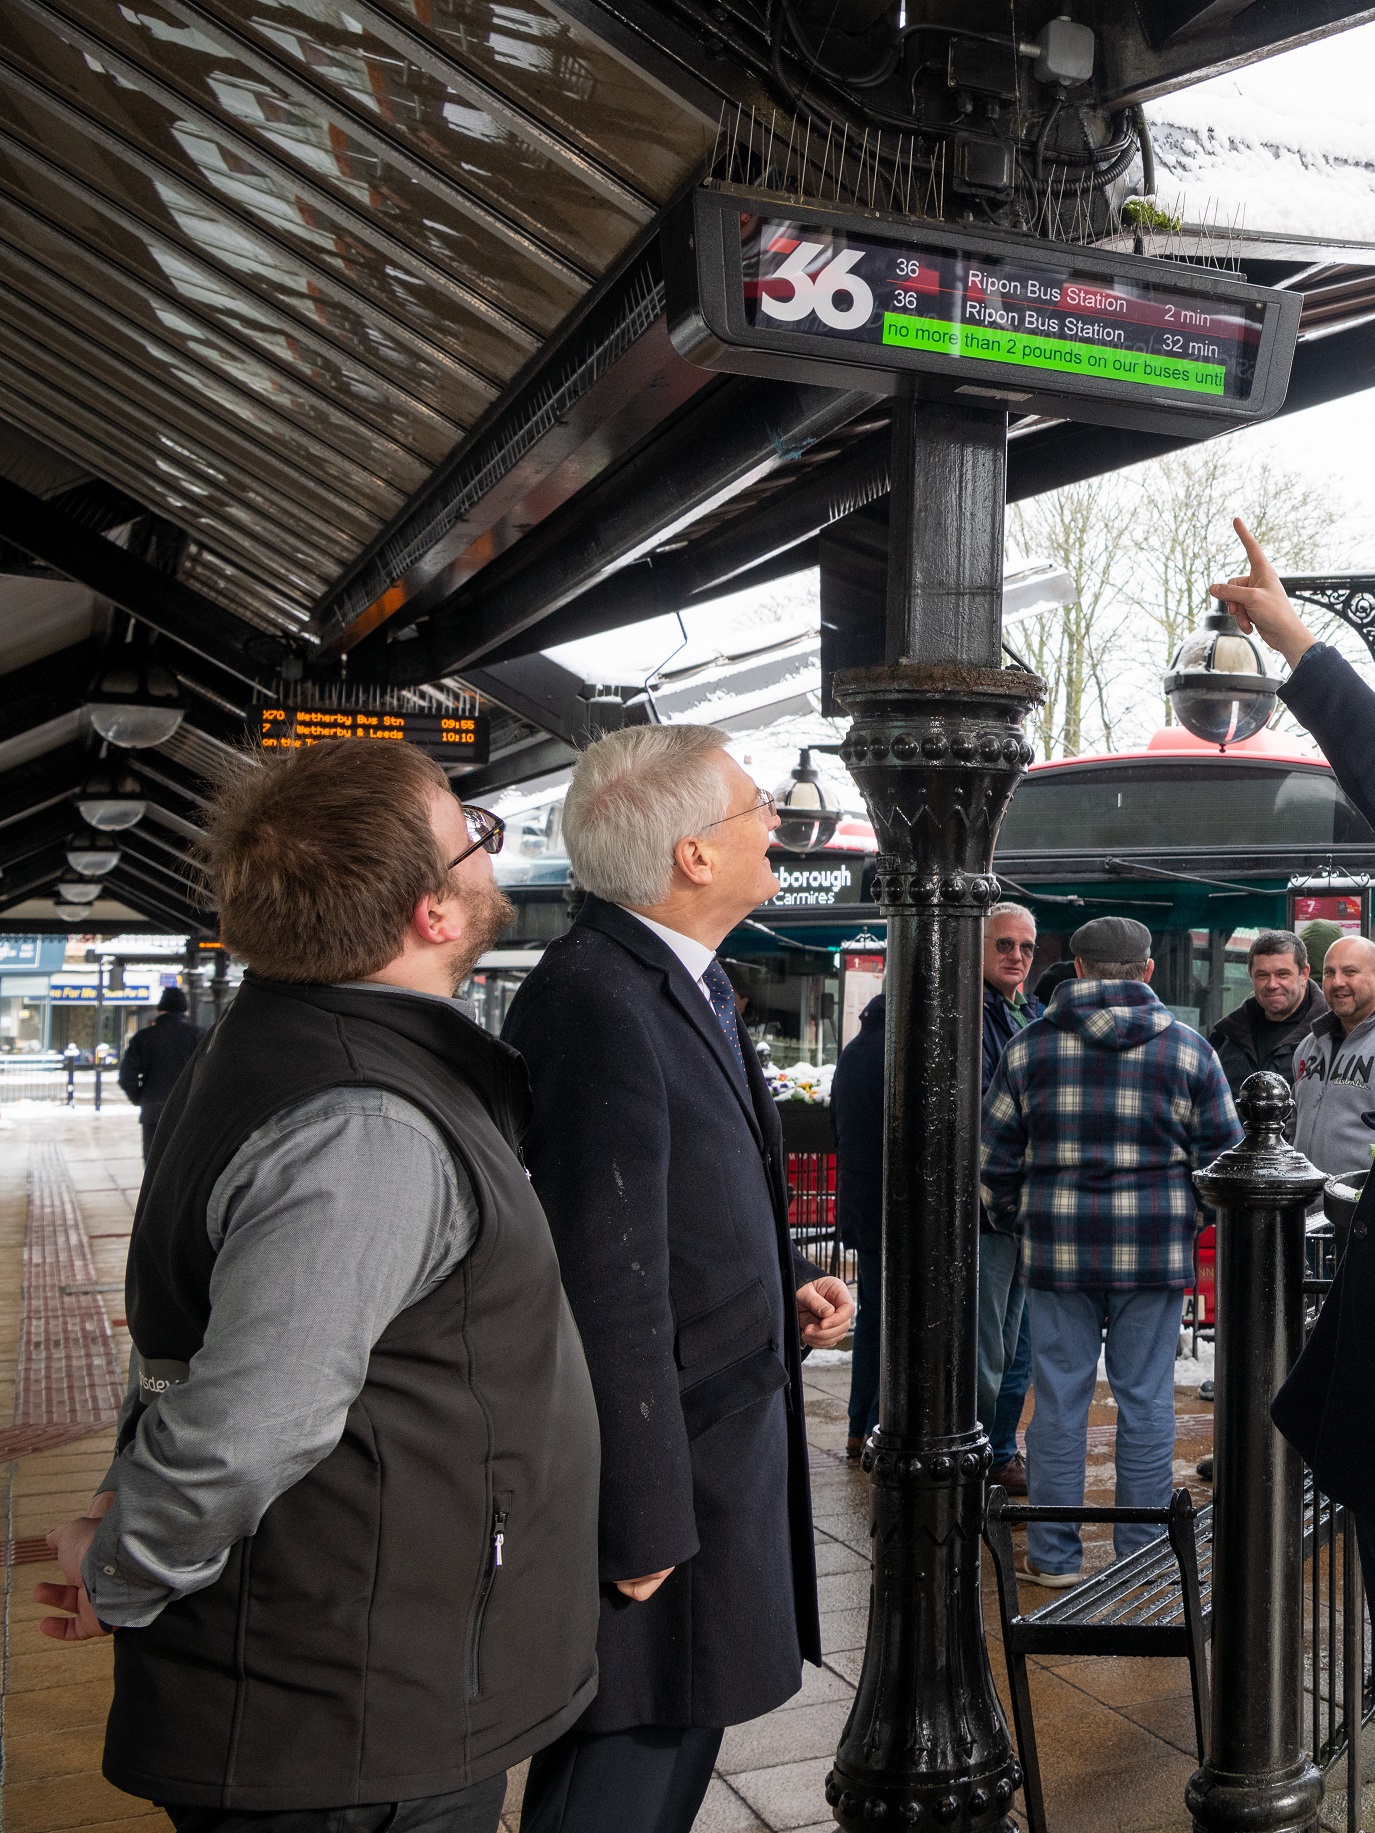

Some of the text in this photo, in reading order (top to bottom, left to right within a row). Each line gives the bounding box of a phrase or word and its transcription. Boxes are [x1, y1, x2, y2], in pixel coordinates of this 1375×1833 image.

[761, 237, 874, 330] 36
[896, 258, 1211, 327] 36 Ripon Bus Station 2 min
[888, 322, 910, 338] no
[915, 327, 959, 346] more
[965, 332, 1000, 352] than
[1007, 338, 1017, 354] 2
[1022, 342, 1083, 365] pounds
[1088, 353, 1108, 369] on
[1112, 356, 1138, 374] our
[1143, 357, 1190, 382] buses
[893, 290, 1219, 358] 36 Ripon Bus Station 32 min
[262, 723, 475, 743] 7 Wetherby & Leeds 10:10
[262, 738, 277, 747] on
[263, 709, 475, 729] X70 Wetherby Bus Stn 09:55
